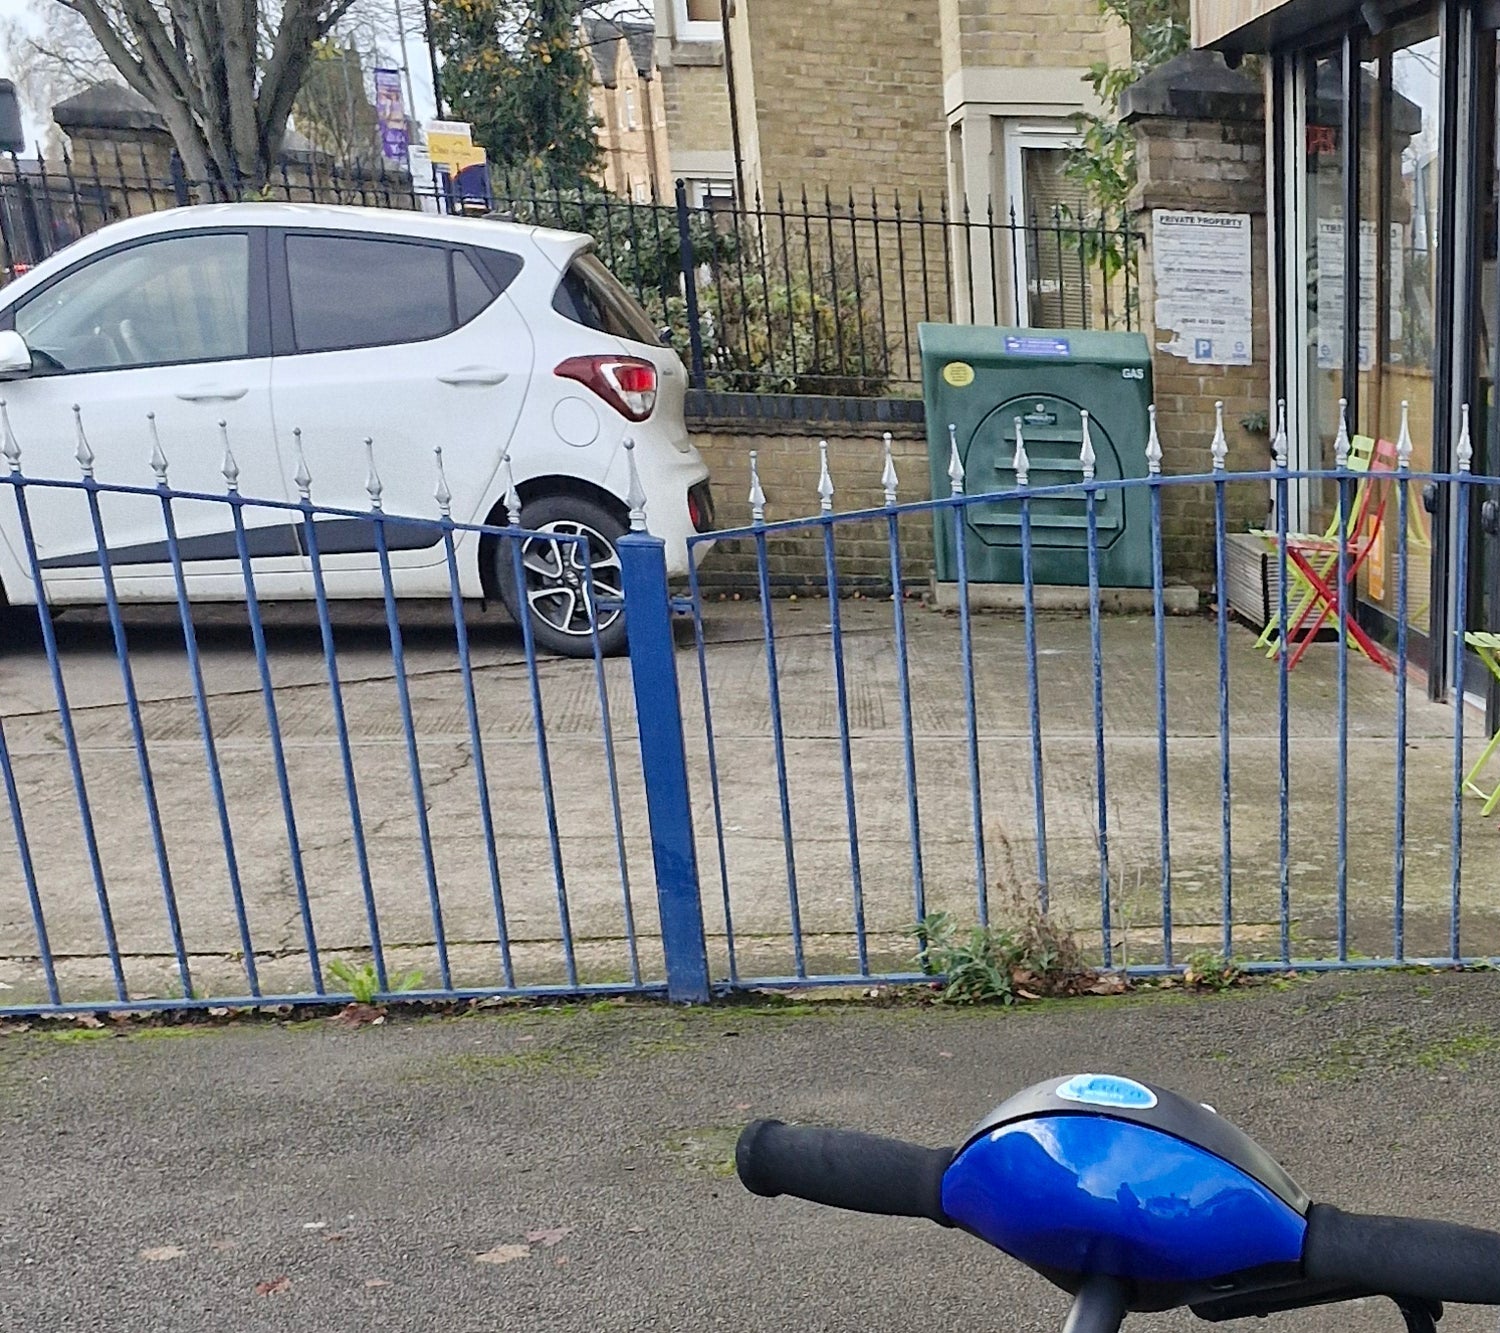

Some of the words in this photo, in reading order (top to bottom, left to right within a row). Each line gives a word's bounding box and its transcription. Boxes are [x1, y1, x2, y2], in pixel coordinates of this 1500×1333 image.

[1160, 216, 1195, 224] PRIVATE
[1197, 217, 1243, 226] PROPERTY
[1122, 368, 1144, 379] GAS
